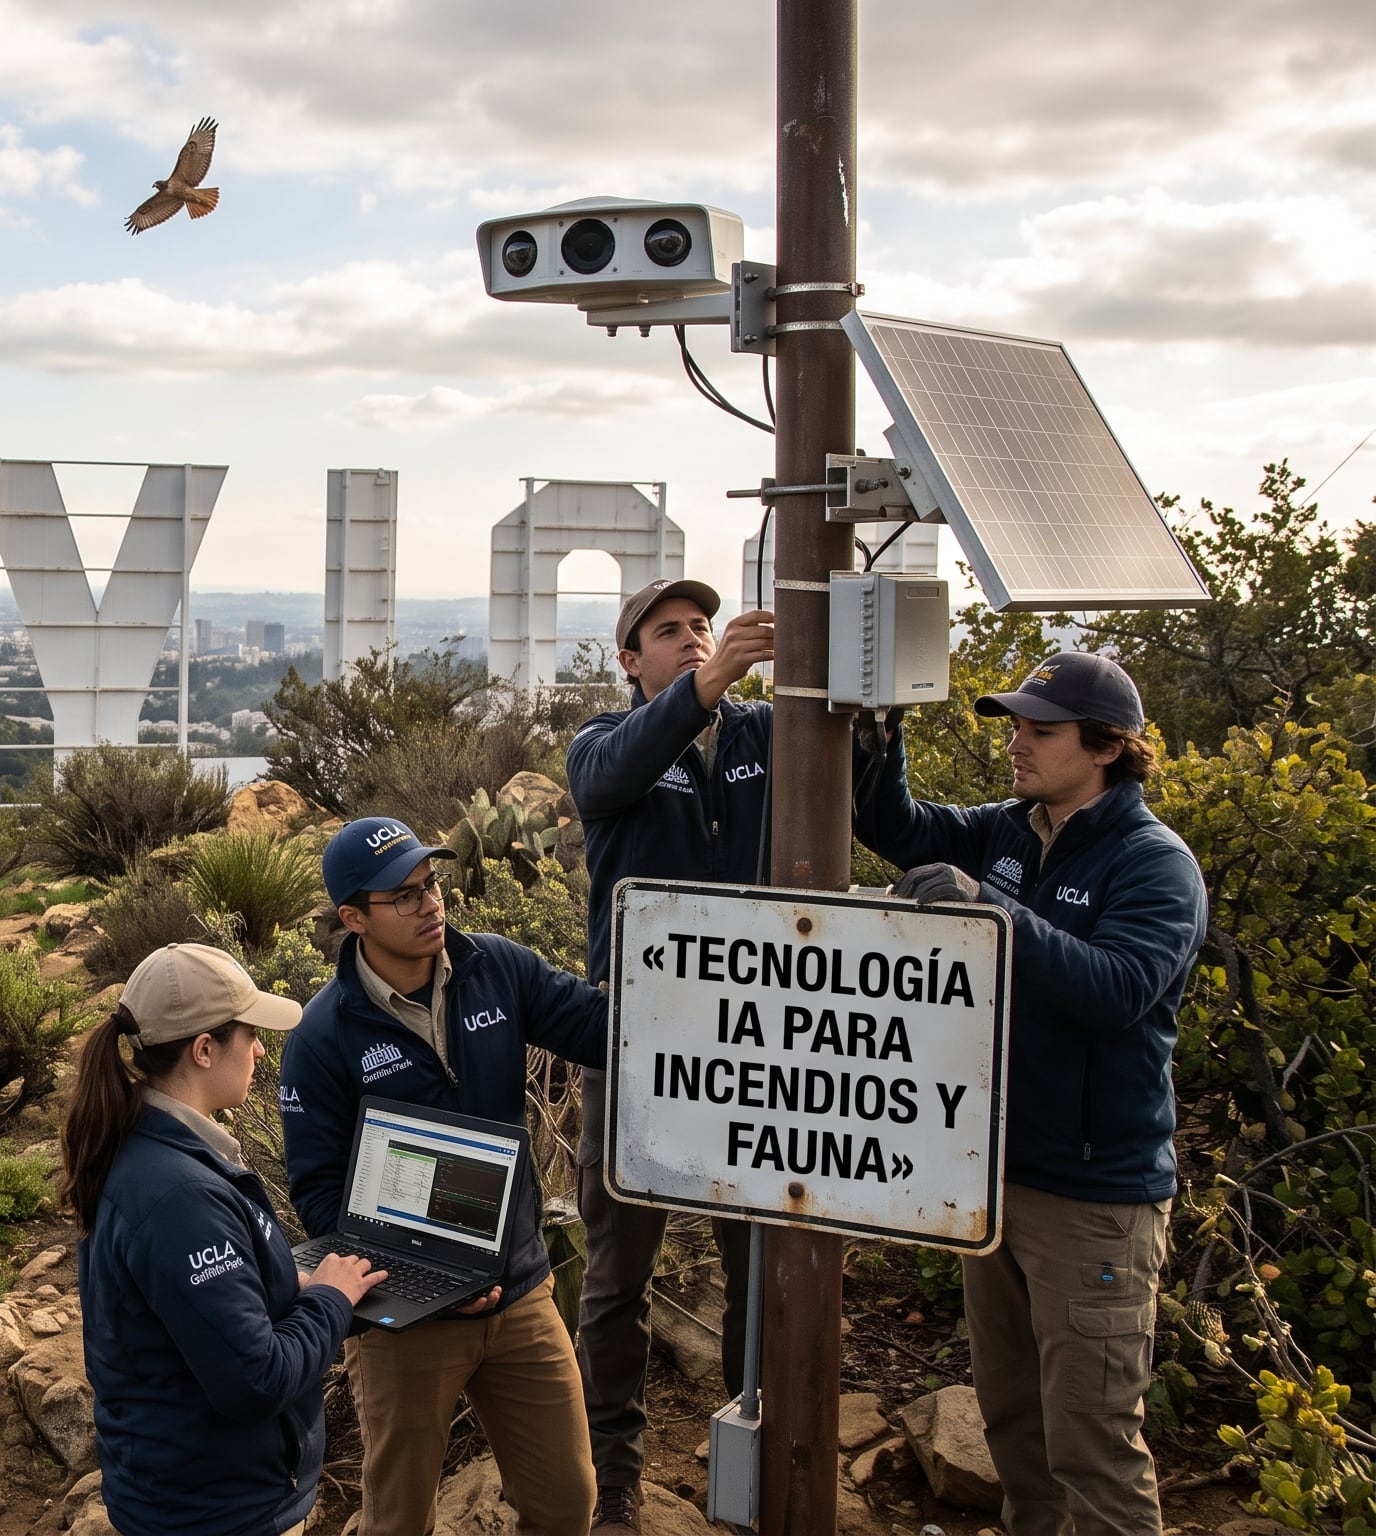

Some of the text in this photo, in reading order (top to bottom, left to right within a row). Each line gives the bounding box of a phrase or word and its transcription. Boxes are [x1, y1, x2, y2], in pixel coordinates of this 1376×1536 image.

[725, 762, 765, 783] UCLA
[365, 824, 407, 848] UCLA
[1056, 886, 1090, 907] UCLA
[642, 932, 975, 1008] «TECNOLOGÍA
[463, 1006, 508, 1032] UCLA
[717, 998, 913, 1063] IA PARA
[653, 1052, 968, 1129] INCENDIOS Y
[727, 1120, 914, 1184] FAUNA»
[188, 1240, 237, 1269] UCLA
